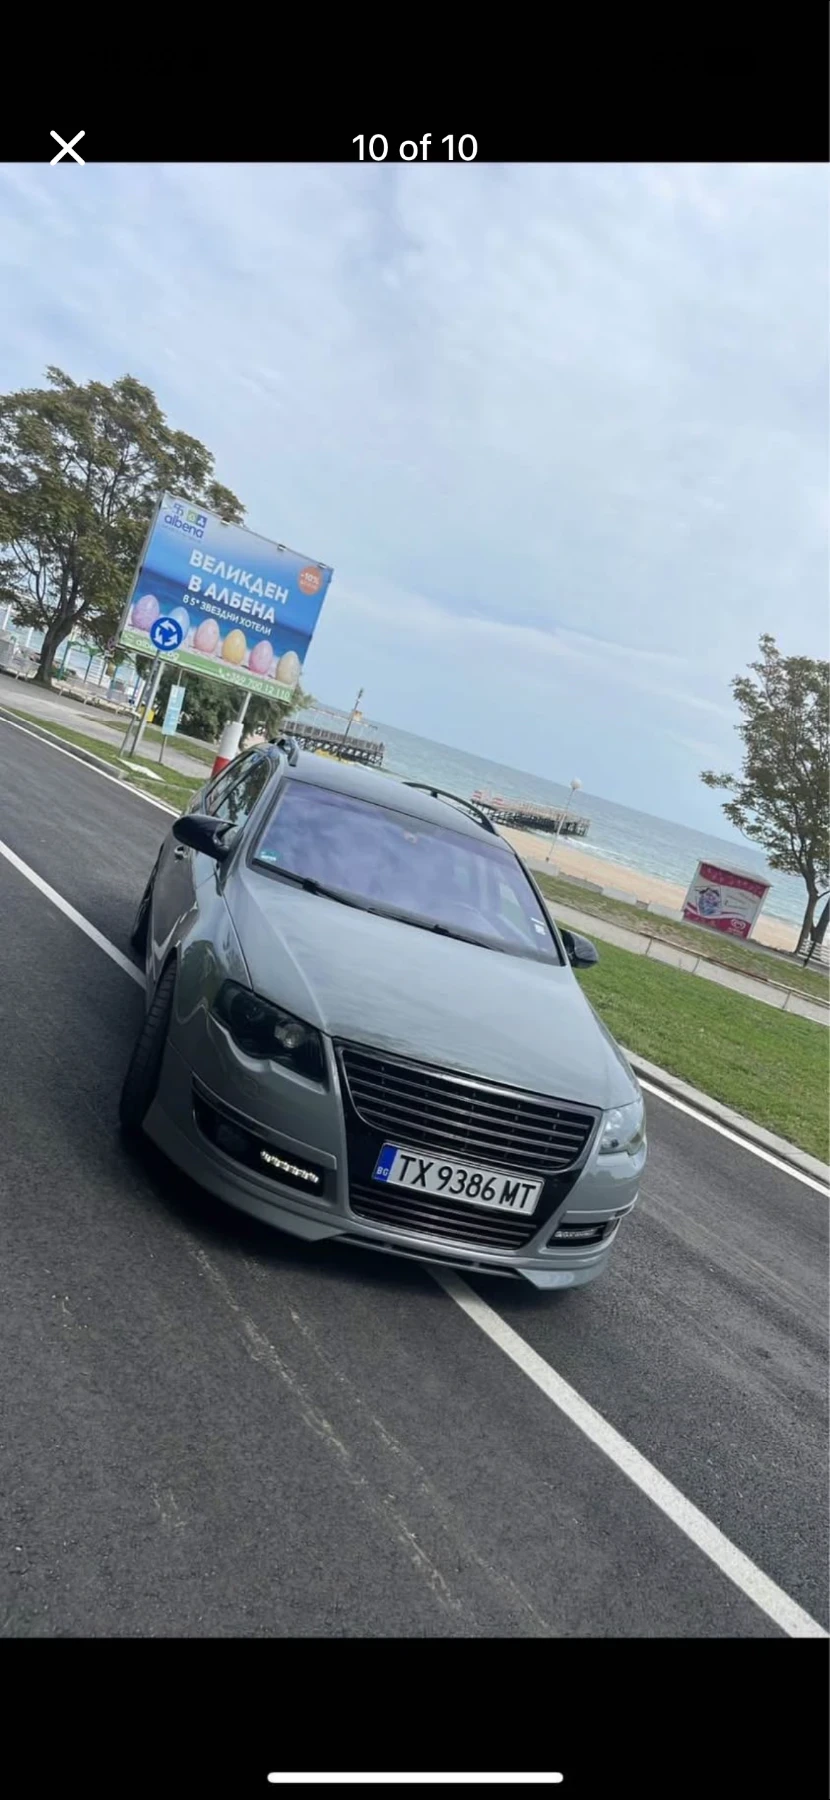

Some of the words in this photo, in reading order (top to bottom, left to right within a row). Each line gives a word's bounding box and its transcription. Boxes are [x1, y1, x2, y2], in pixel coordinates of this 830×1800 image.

[164, 514, 205, 539] albena
[189, 549, 289, 604] ВЕЛИКДЕН
[188, 575, 203, 593] В
[204, 583, 276, 624] АЛБЕНА
[200, 601, 239, 623] ЗВЕЗДНИ
[239, 618, 272, 636] ХОТЕЛИ
[376, 1166, 389, 1177] BG
[399, 1154, 434, 1187] TX
[437, 1166, 497, 1201] 9386
[498, 1180, 537, 1209] MT
